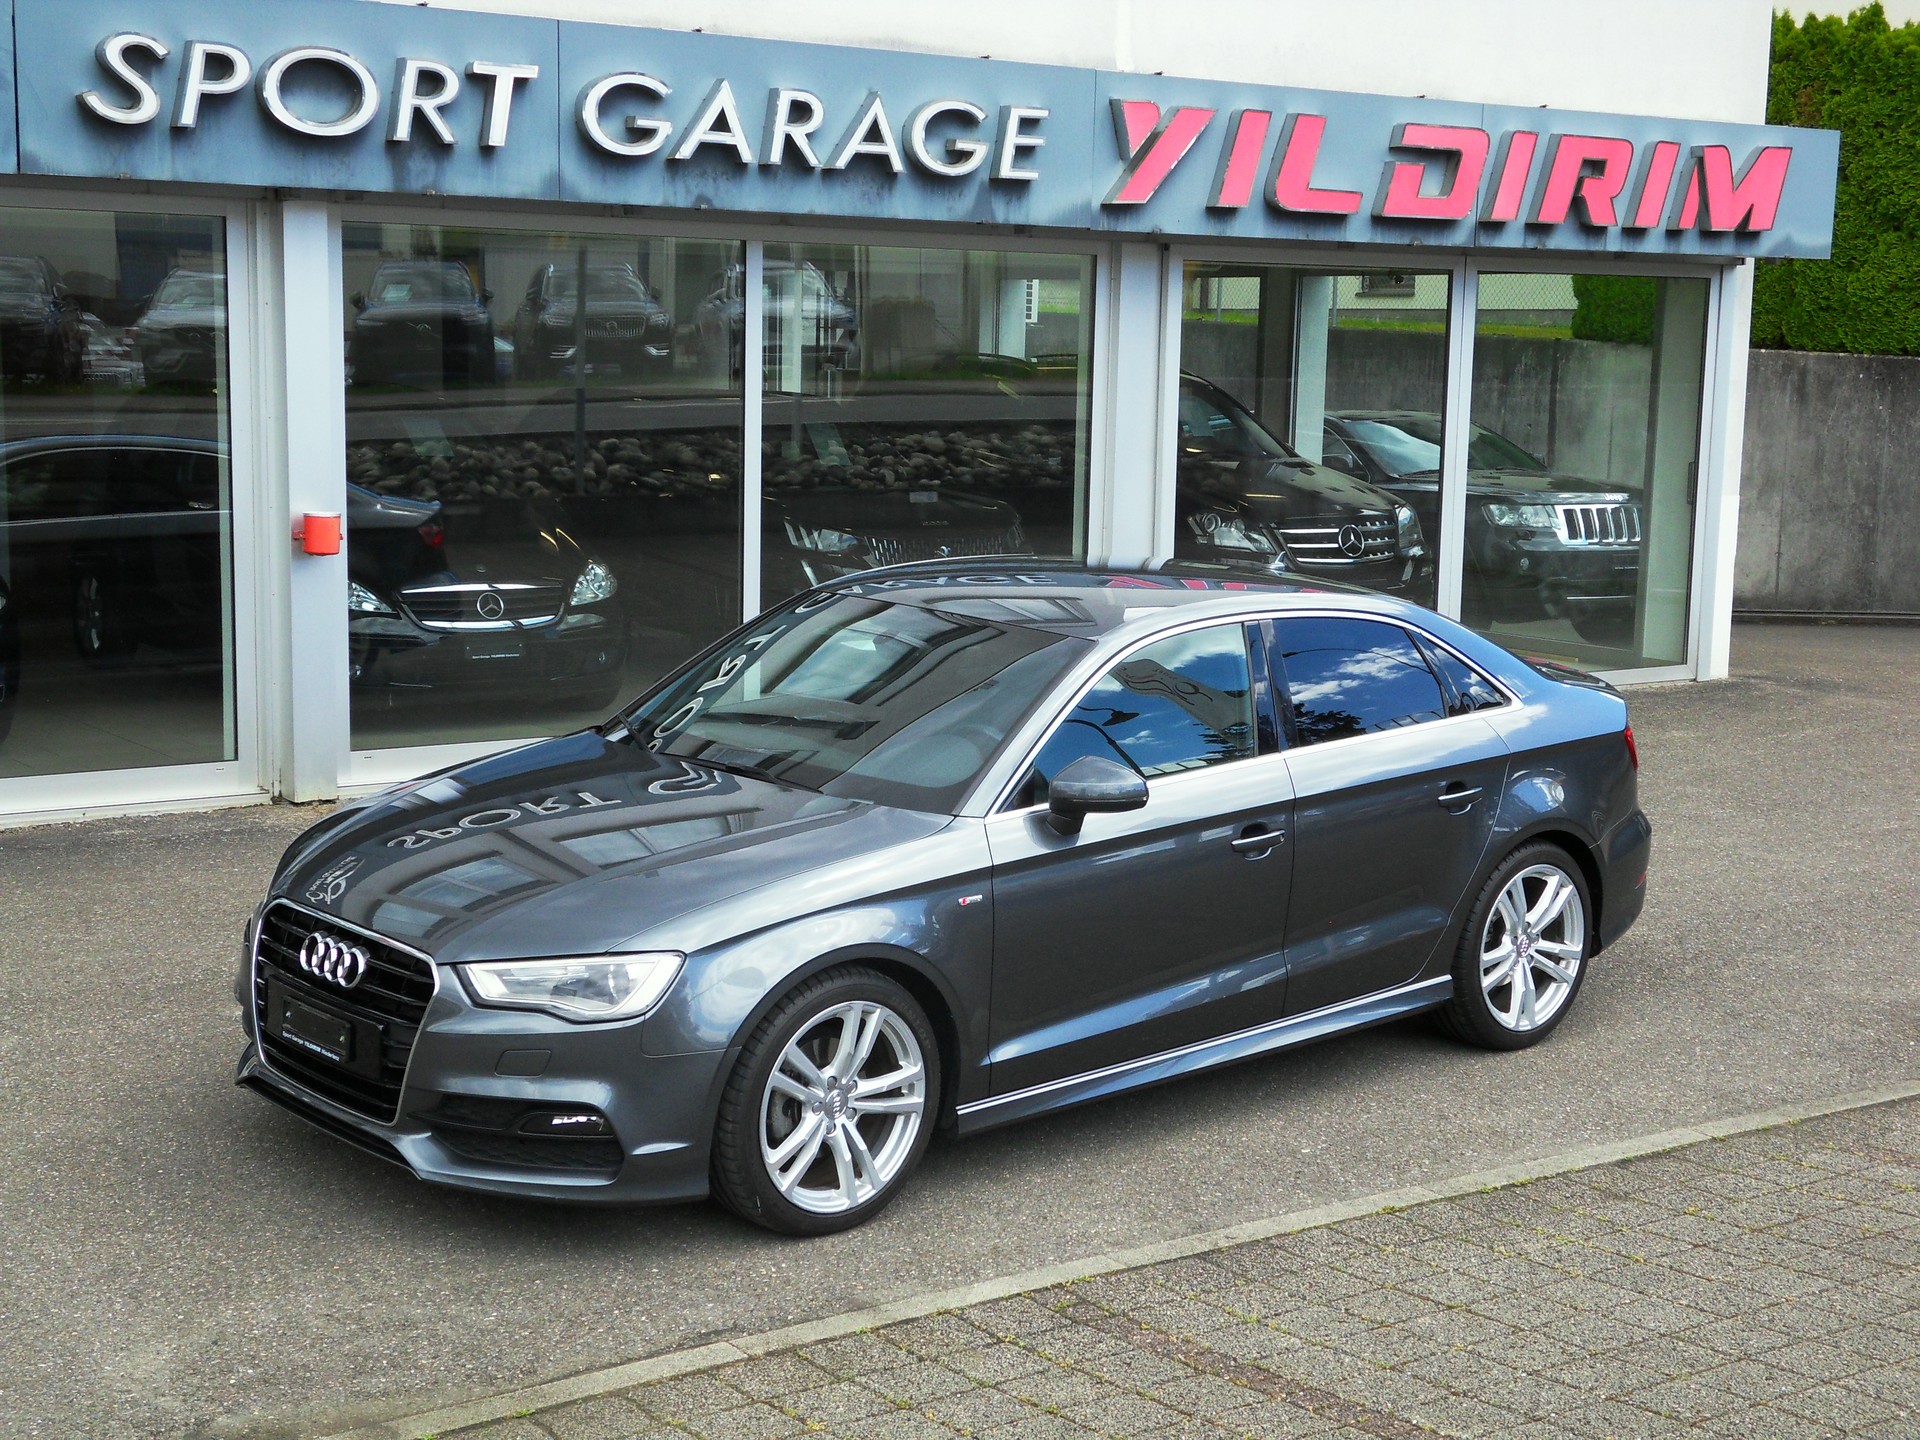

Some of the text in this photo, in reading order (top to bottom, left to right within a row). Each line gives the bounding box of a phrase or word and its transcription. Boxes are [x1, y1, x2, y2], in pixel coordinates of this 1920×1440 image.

[75, 31, 1793, 233] SPORT GARAGE YILDIRIM
[1604, 492, 1624, 502] Jeep
